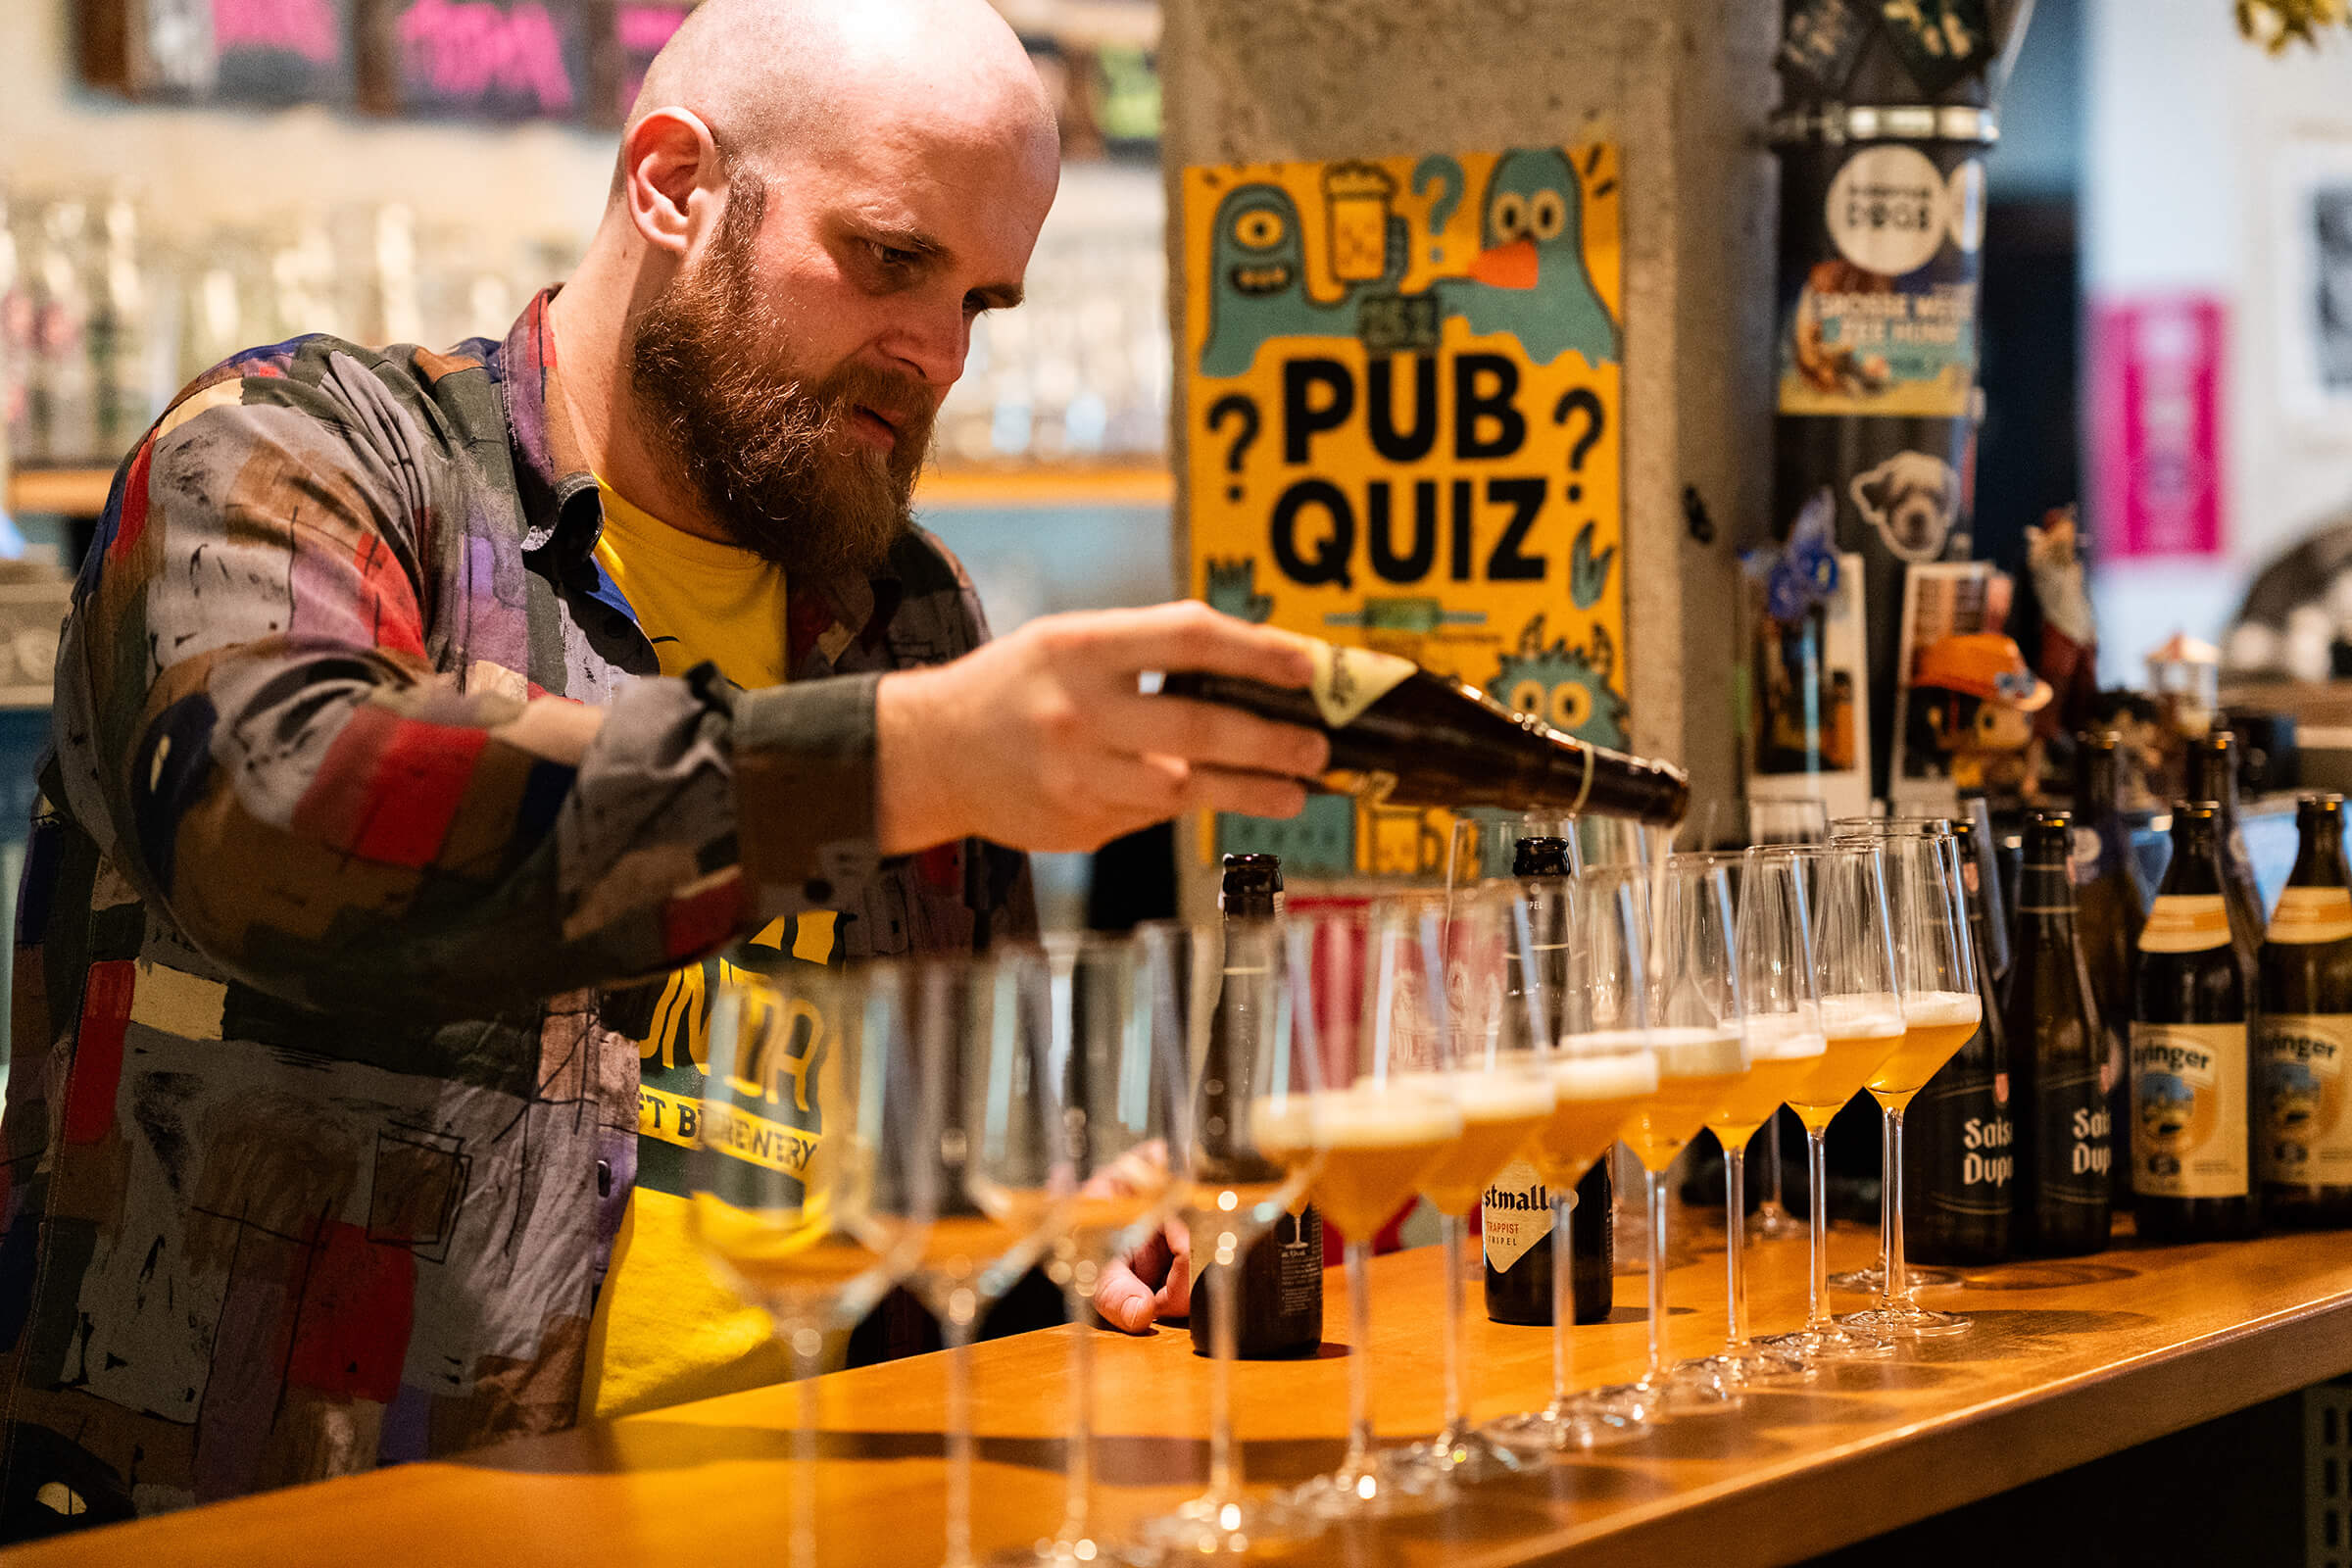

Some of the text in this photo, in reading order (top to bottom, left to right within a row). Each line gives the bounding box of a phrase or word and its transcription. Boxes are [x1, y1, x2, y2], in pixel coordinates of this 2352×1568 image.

[1284, 353, 1527, 466] PUB
[1269, 475, 1548, 591] QUIZ
[1487, 1221, 1520, 1235] TRAPPIST
[1488, 1236, 1518, 1247] TRIPEL
